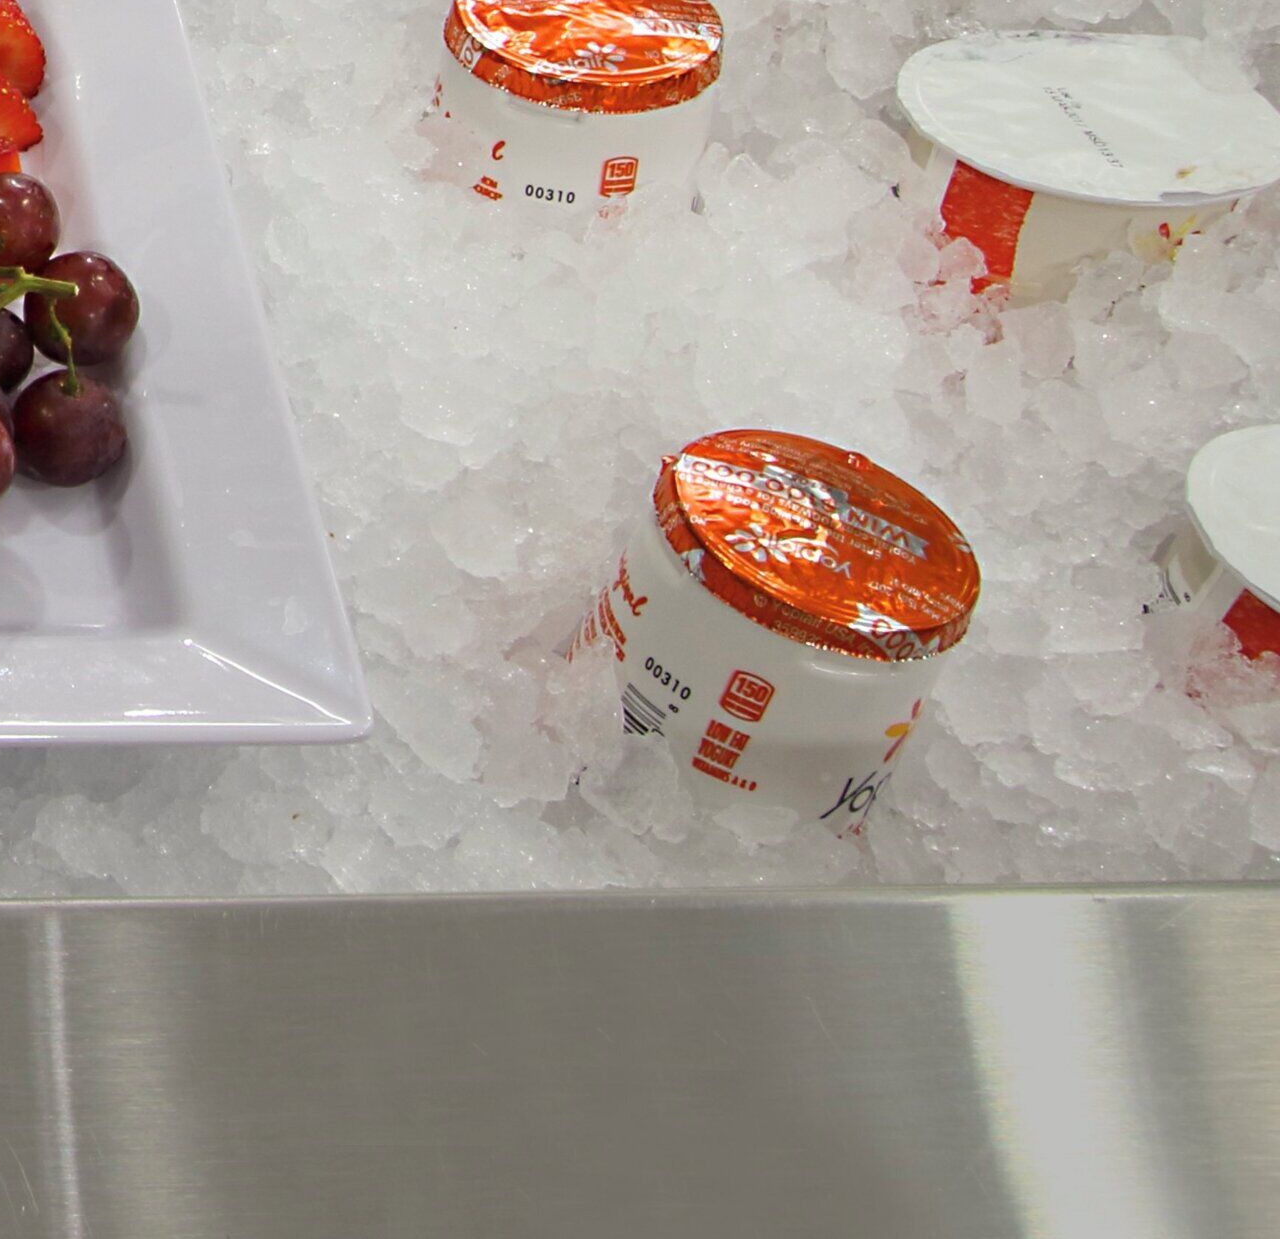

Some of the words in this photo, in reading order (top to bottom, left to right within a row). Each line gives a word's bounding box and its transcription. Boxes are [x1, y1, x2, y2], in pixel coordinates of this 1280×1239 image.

[609, 162, 634, 178] 150
[525, 184, 576, 204] 00310
[645, 657, 691, 699] 00310
[735, 678, 769, 702] 150
